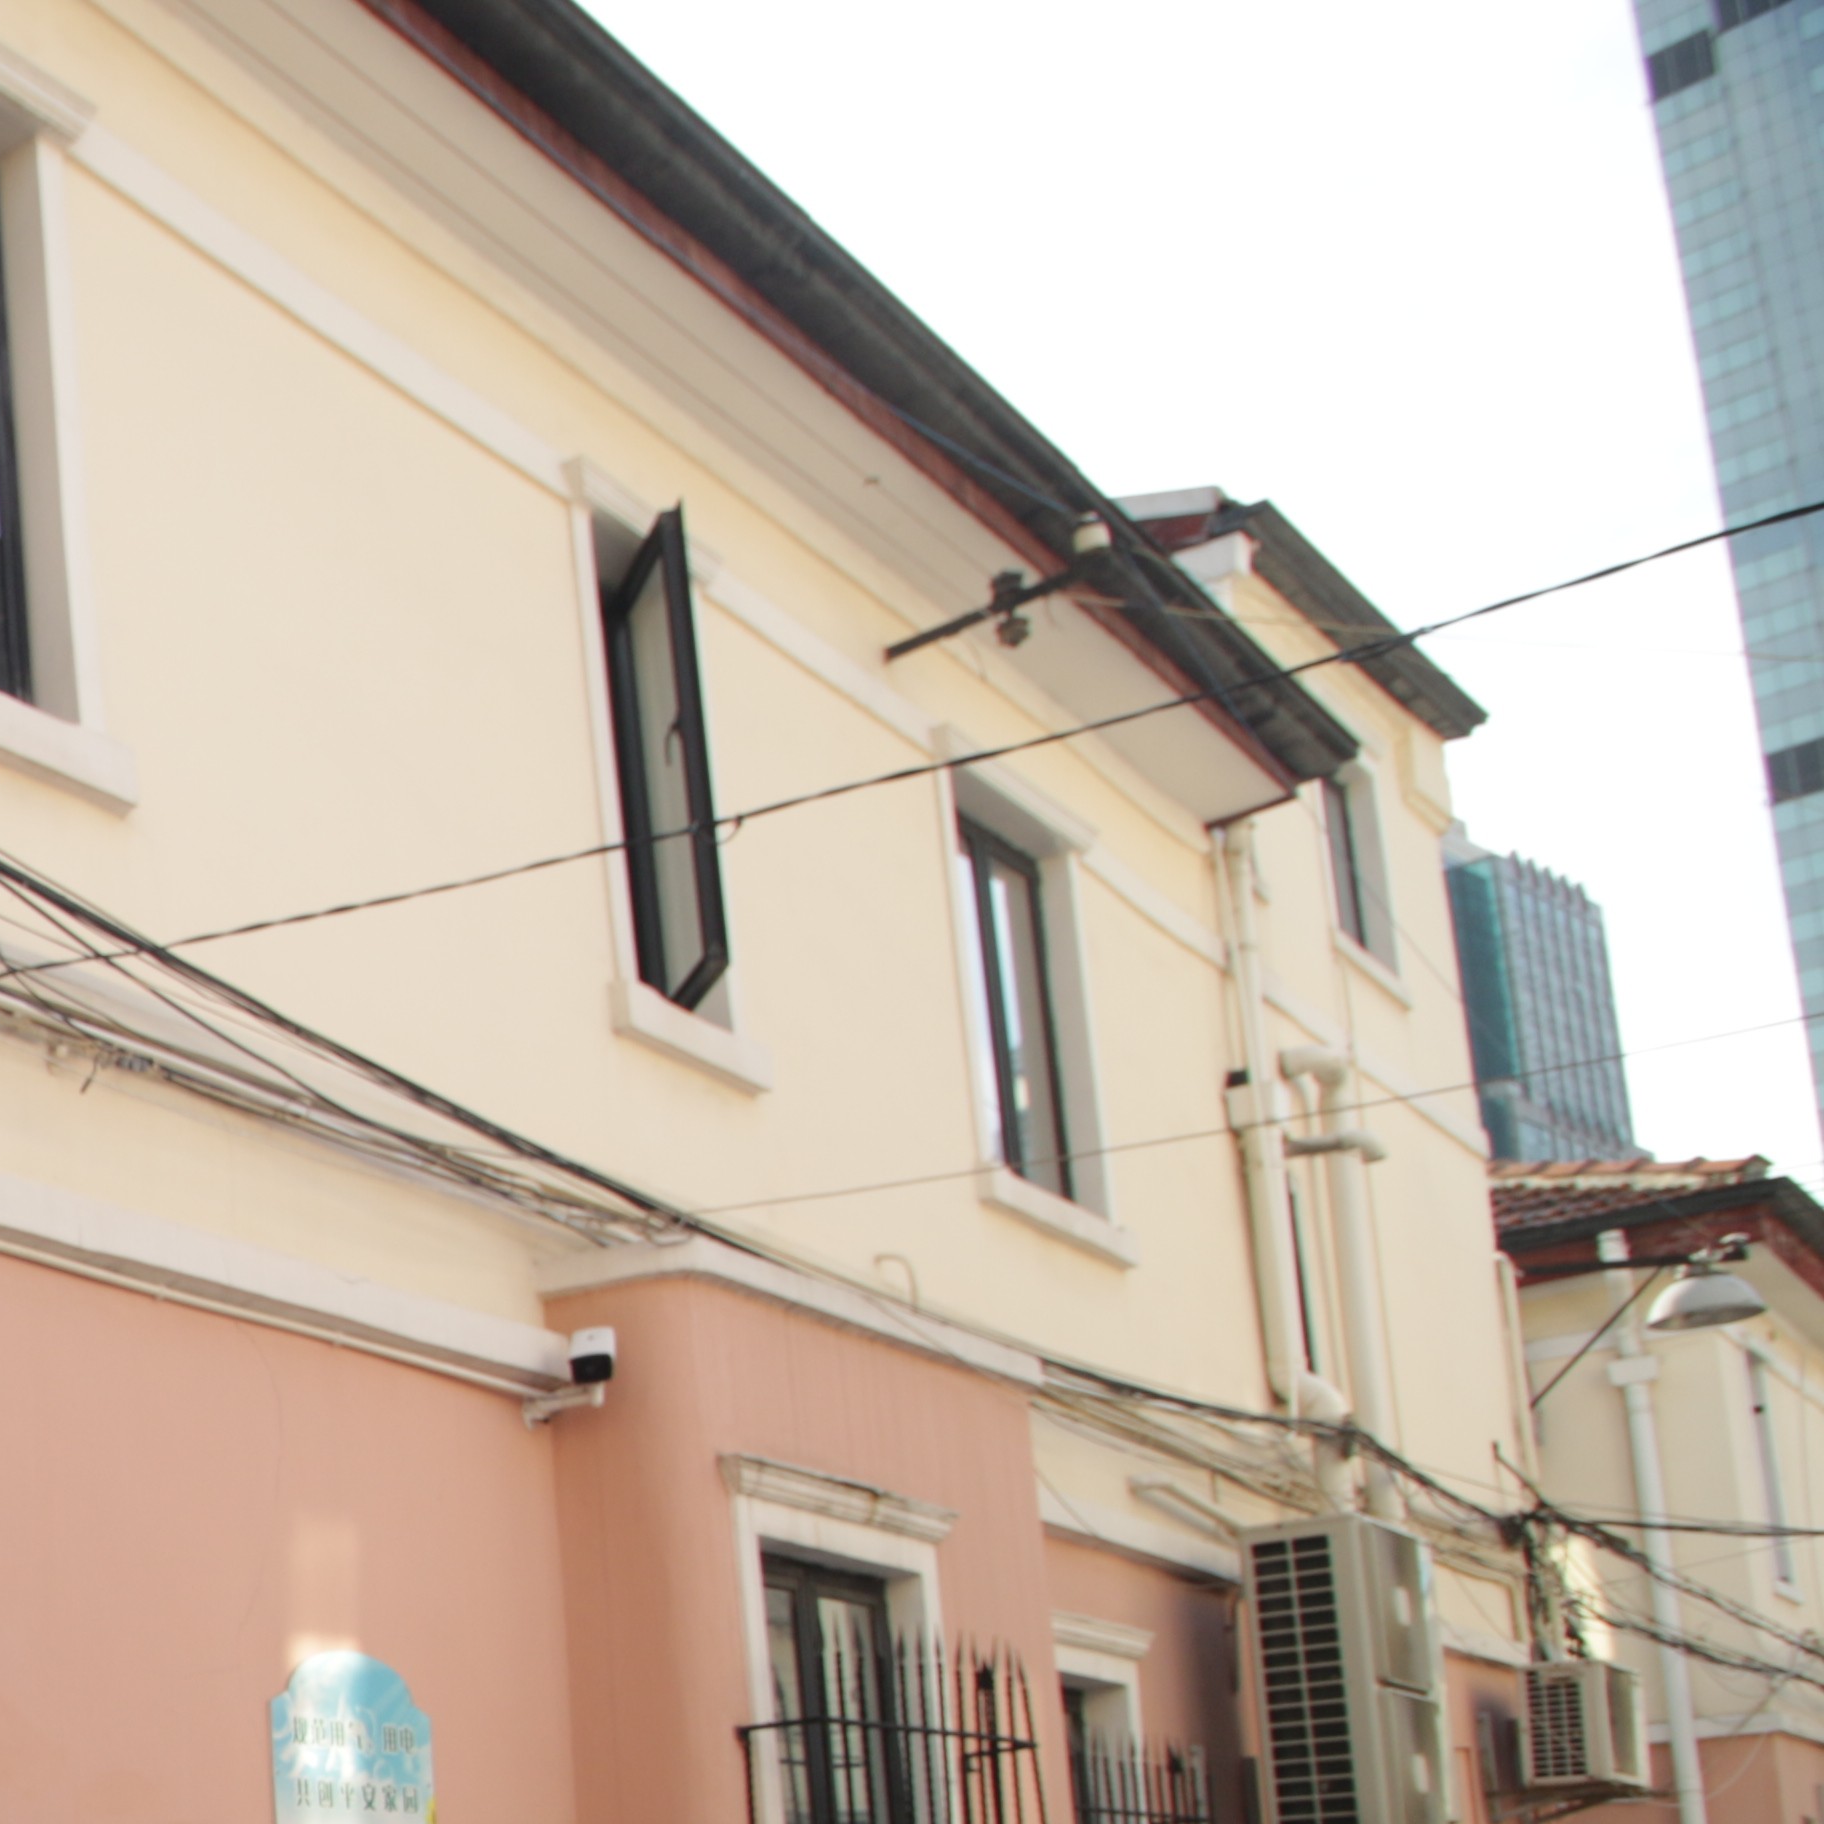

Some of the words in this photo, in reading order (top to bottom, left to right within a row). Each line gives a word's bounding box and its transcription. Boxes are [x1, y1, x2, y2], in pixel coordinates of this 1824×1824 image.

[296, 1778, 419, 1813] 共创平安家园
